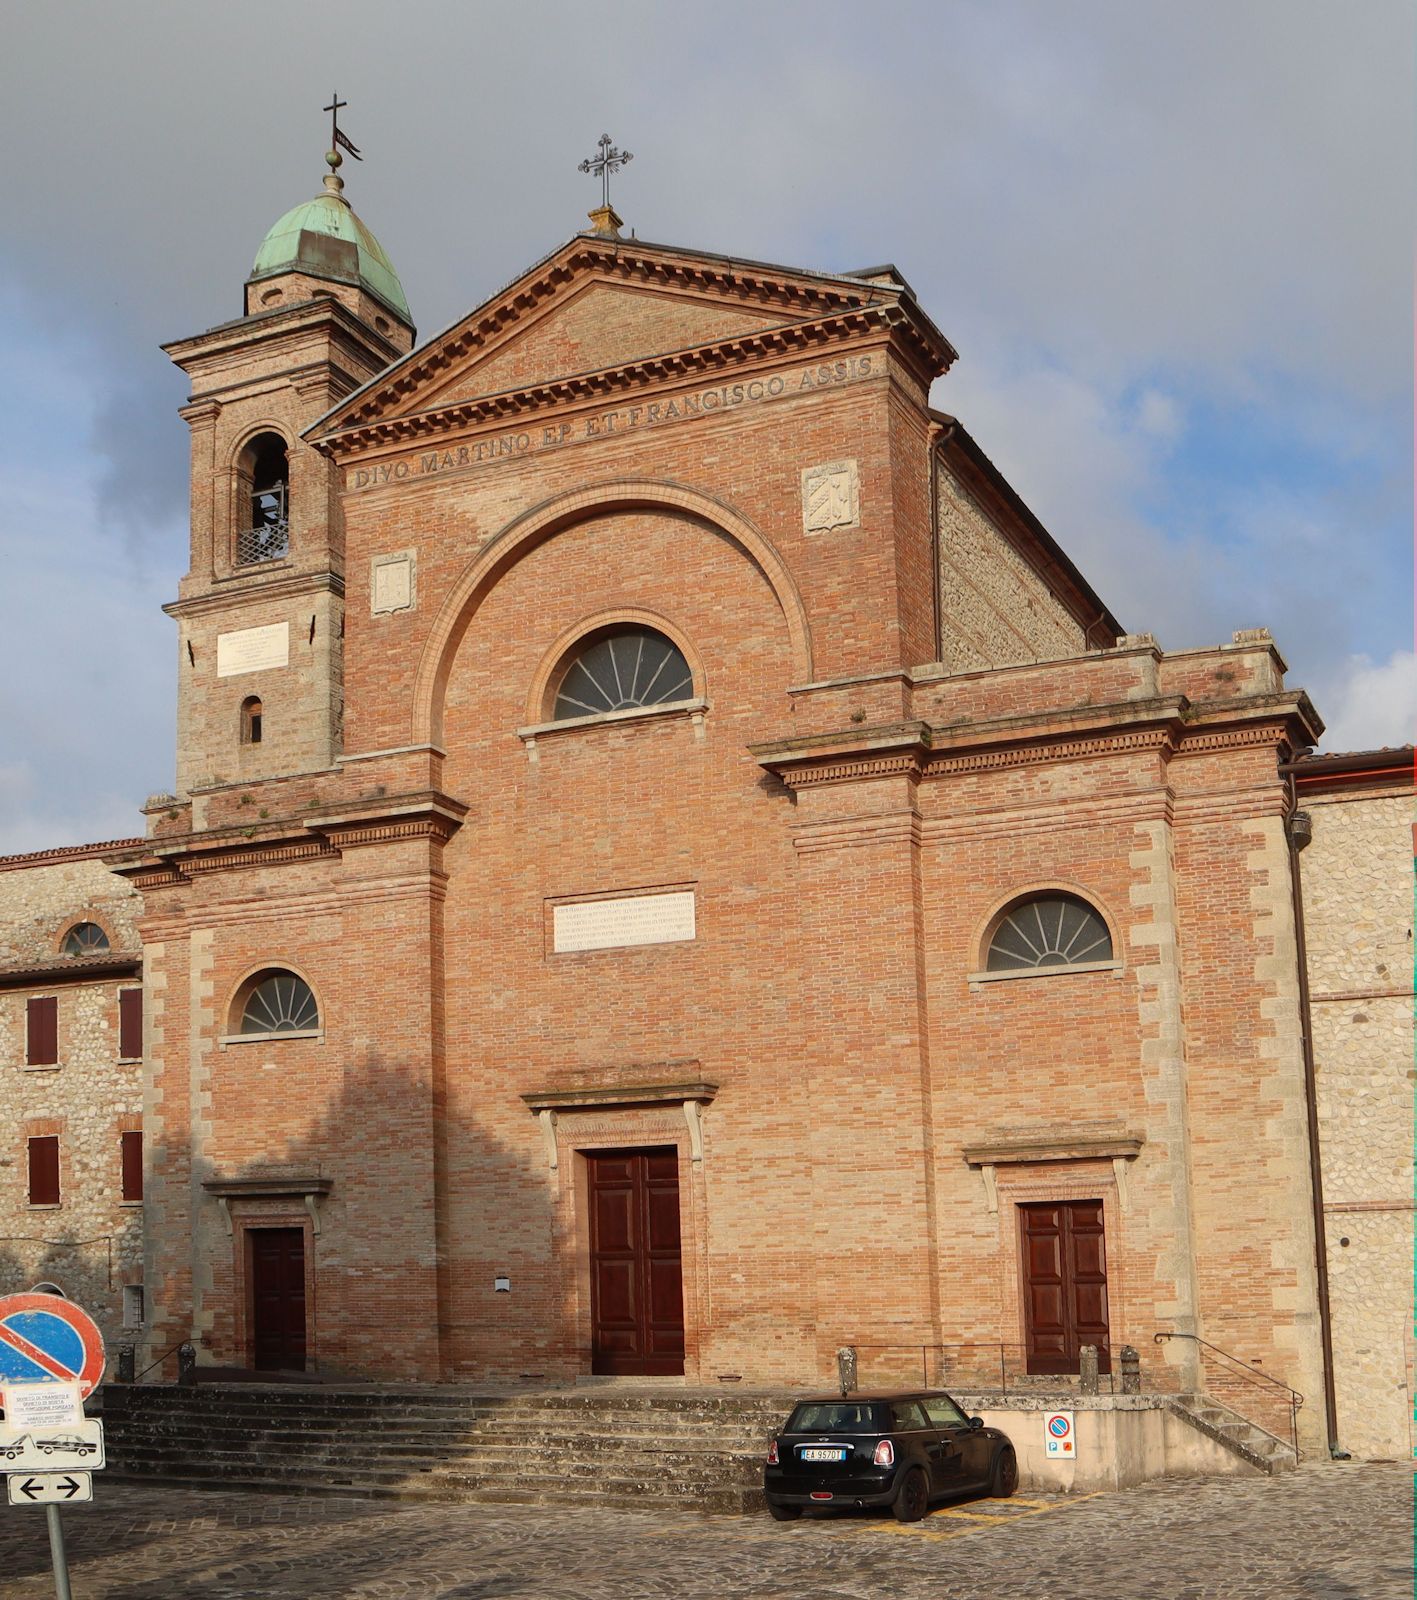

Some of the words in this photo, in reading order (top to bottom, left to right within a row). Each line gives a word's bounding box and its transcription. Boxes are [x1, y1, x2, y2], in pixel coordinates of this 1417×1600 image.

[355, 461, 408, 488] DIVO
[421, 433, 530, 473] MARTINO
[585, 412, 618, 436] ET
[629, 377, 785, 426] FRANCISCO
[806, 1451, 815, 1459] EA
